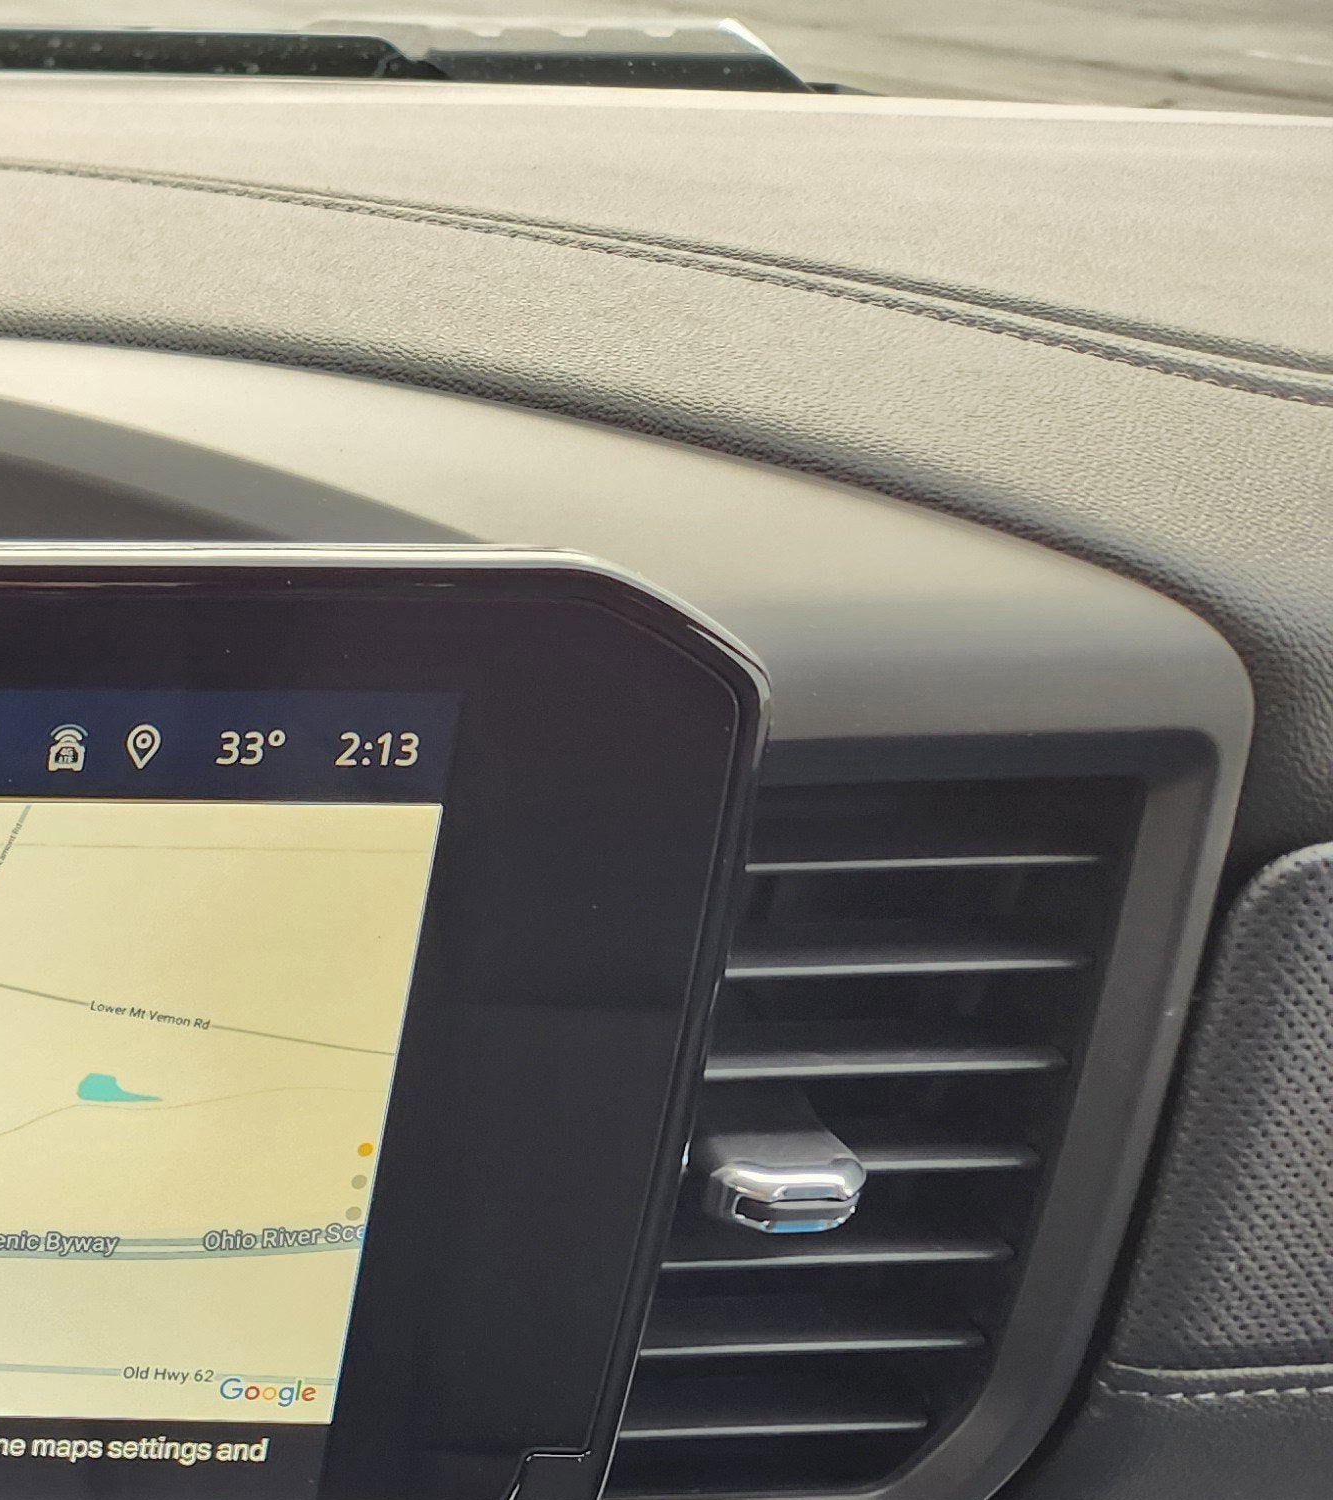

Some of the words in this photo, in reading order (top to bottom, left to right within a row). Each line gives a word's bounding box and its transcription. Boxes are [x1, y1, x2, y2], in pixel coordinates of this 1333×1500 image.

[215, 729, 286, 766] 33°
[335, 731, 420, 768] 2:13
[90, 1001, 126, 1017] Lower
[130, 1007, 146, 1020] Mt
[149, 1010, 190, 1027] Vernon
[194, 1017, 210, 1030] Rd
[44, 1231, 120, 1257] Byway
[202, 1229, 257, 1250] Ohio
[261, 1226, 321, 1248] River
[123, 1366, 150, 1380] Old
[154, 1368, 190, 1385] Hwy
[193, 1369, 214, 1382] 62
[220, 1377, 316, 1407] Google
[31, 1439, 102, 1462] maps
[106, 1436, 212, 1466] settings
[216, 1438, 268, 1463] and
